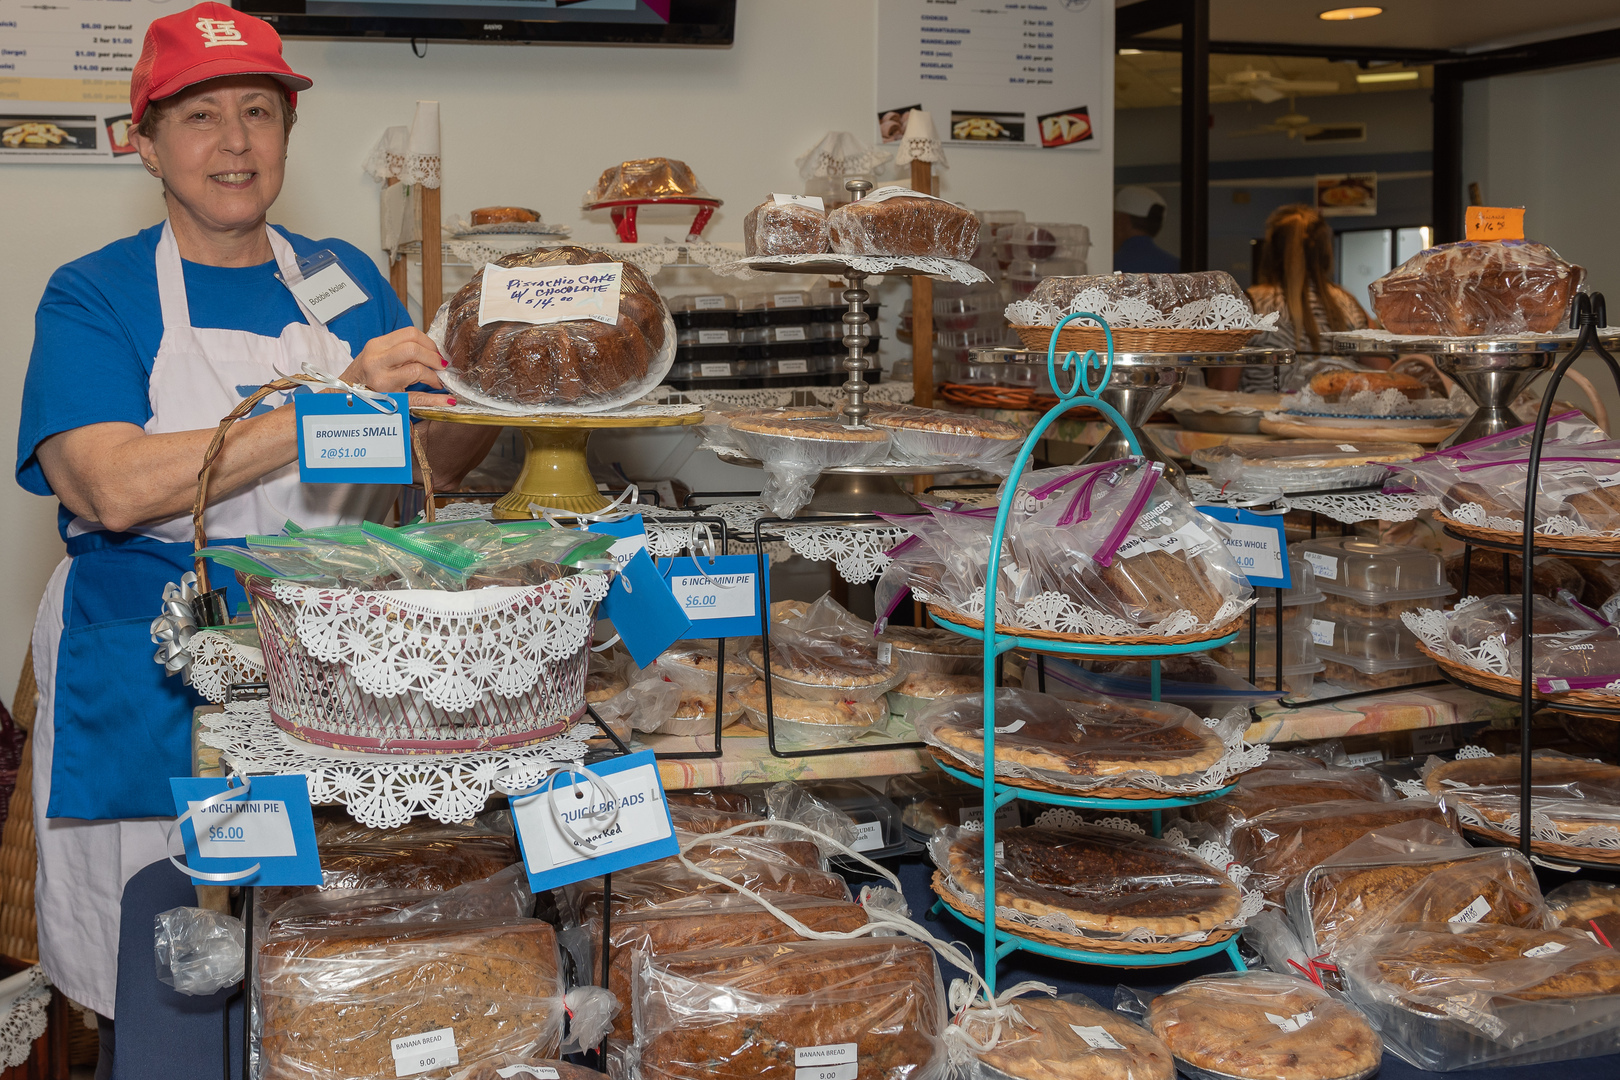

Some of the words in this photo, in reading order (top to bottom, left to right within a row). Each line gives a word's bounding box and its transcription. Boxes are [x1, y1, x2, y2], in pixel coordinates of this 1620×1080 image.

[578, 273, 617, 284] CAKE
[309, 291, 330, 306] Bobbie
[329, 281, 347, 295] Nolan
[535, 284, 611, 297] CHOCOLATE
[316, 429, 360, 438] BROWNIES
[362, 426, 398, 437] SMALL
[320, 447, 367, 459] 2@$1.00
[1137, 500, 1173, 525] STRONGER
[1141, 514, 1161, 531] SEAL
[1222, 538, 1243, 548] CAKES
[1244, 540, 1267, 549] WHOLE
[682, 578, 688, 587] 6
[689, 577, 712, 586] INCH
[713, 576, 735, 585] MINI
[736, 575, 750, 584] PIE
[685, 595, 717, 608] $6.00
[209, 803, 233, 813] INCH
[235, 803, 261, 813] MINI
[263, 803, 280, 813] PIE
[599, 792, 645, 814] BREADS
[209, 825, 245, 840] $6.00
[395, 1038, 422, 1050] BANANA
[422, 1035, 442, 1046] BREAD
[419, 1057, 436, 1067] 9.00
[819, 1072, 836, 1080] 9.00
